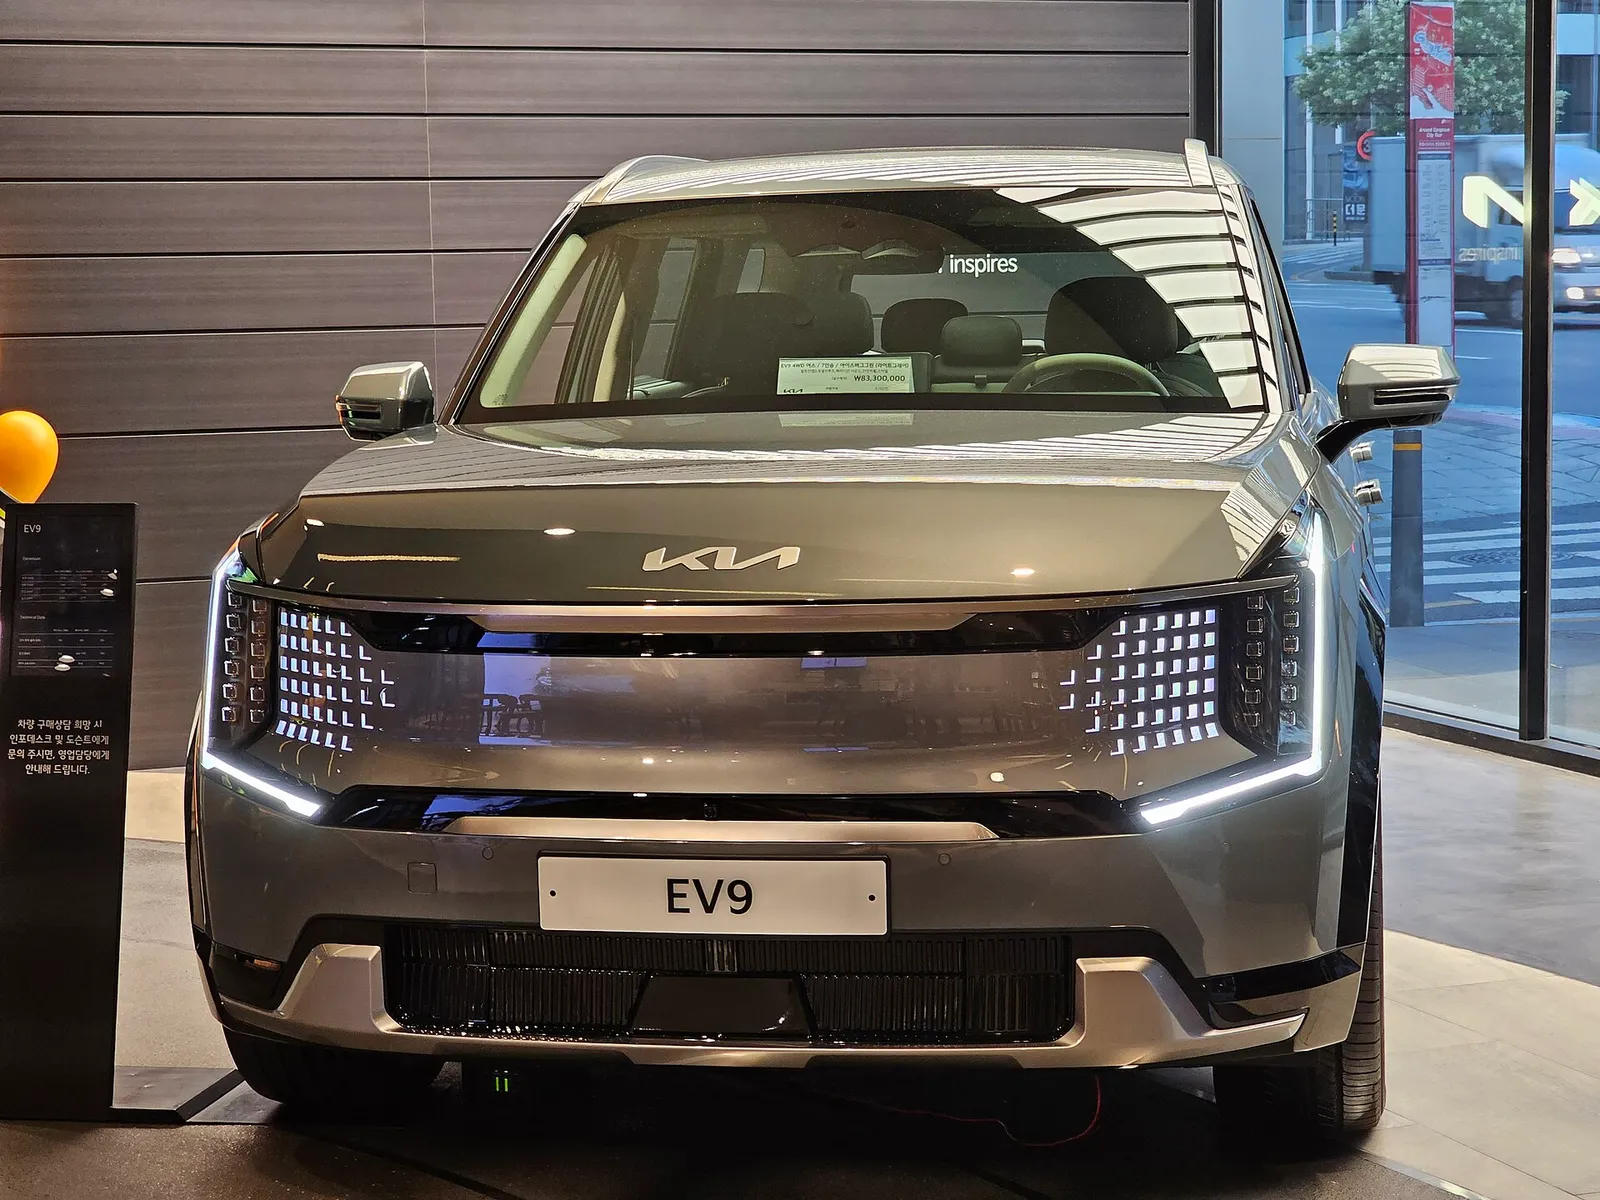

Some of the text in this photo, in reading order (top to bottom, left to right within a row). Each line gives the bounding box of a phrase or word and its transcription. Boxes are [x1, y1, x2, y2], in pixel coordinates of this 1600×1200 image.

[949, 253, 1018, 278] inspires
[23, 524, 42, 533] EV9
[17, 719, 103, 730] 차량 구매상담 희망 시
[9, 734, 109, 745] 인포데스크 및 도슨트에게
[7, 749, 110, 760] 문의 주시면, 영업담당에게
[25, 764, 91, 776] 안내해 드립니다.
[666, 878, 754, 915] EV9
